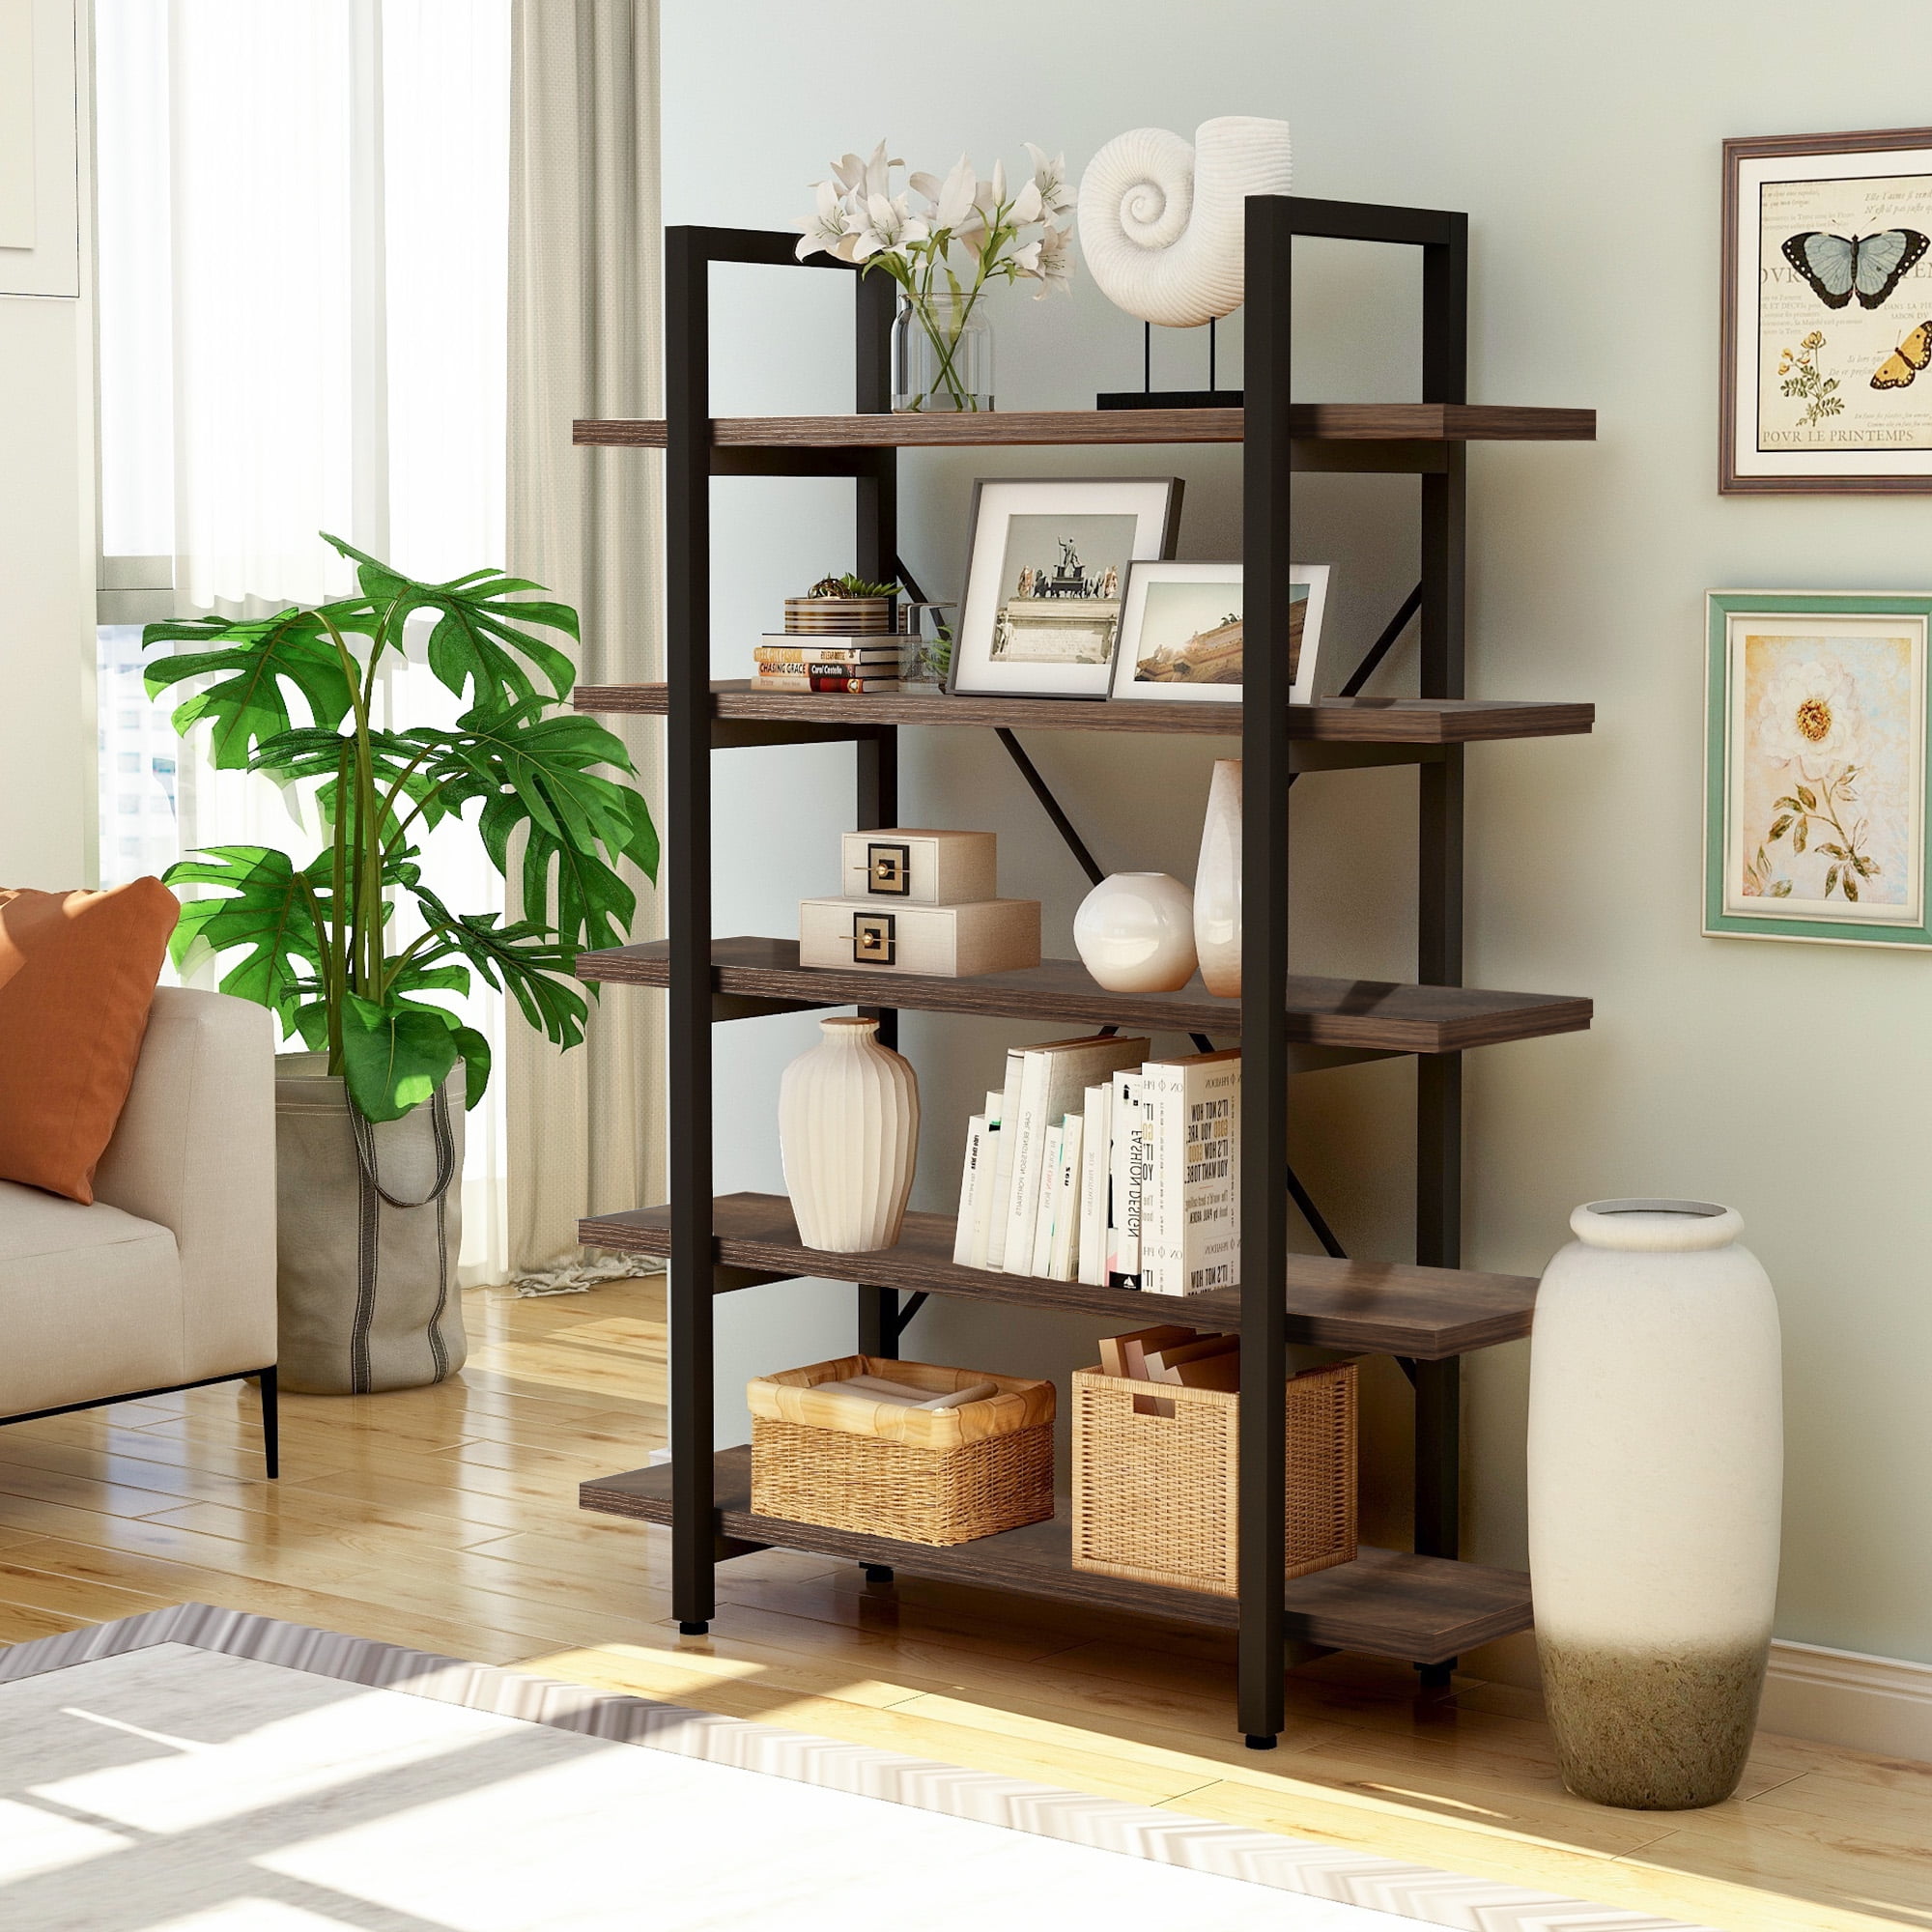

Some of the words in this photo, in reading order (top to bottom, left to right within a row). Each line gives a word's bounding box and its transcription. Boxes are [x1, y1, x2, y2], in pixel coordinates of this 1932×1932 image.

[1762, 431, 1802, 442] POVR
[1808, 431, 1826, 442] LE
[1830, 430, 1914, 442] PRINTEMPS
[760, 663, 785, 674] CHASING
[786, 664, 806, 675] GRACE
[811, 665, 824, 675] Carol
